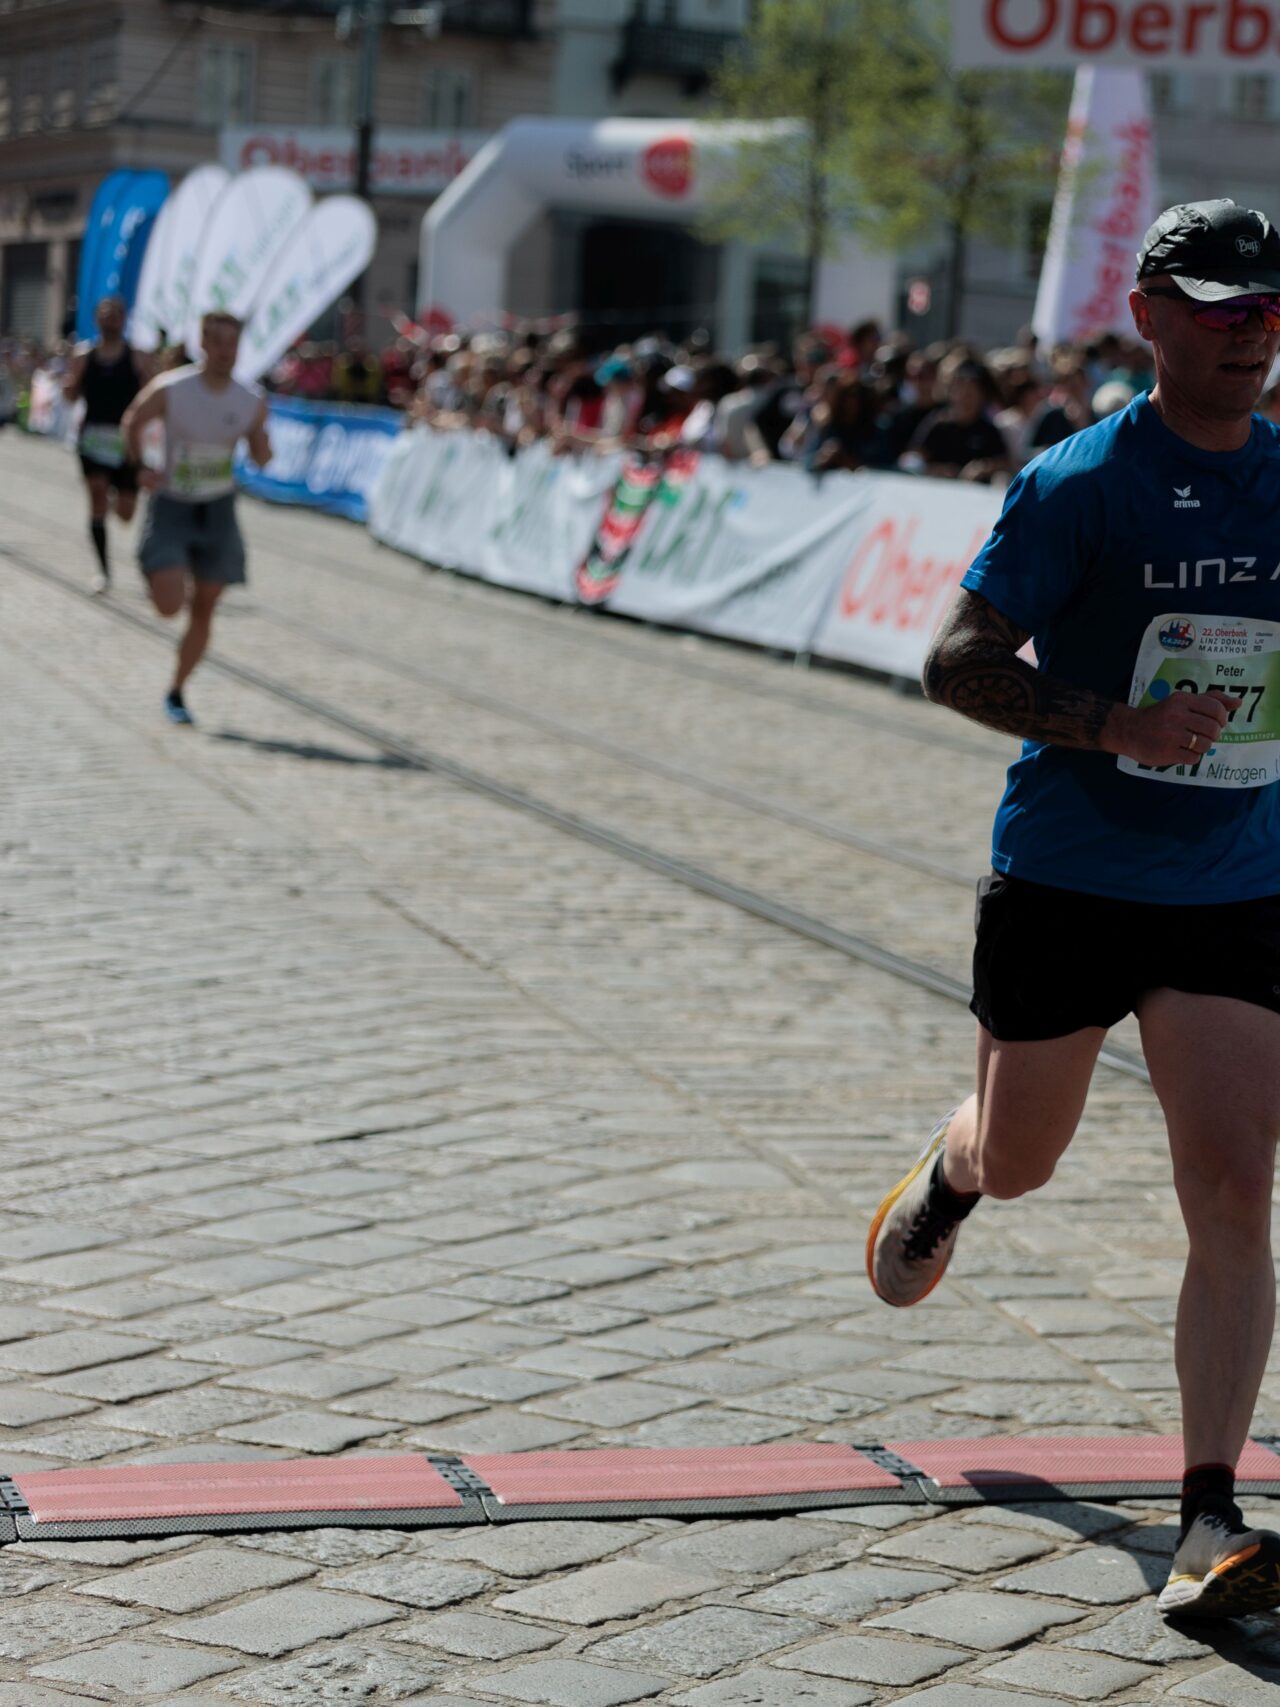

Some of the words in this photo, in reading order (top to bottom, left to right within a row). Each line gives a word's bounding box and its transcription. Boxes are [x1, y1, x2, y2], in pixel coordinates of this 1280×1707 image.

[1172, 497, 1201, 509] erima
[1143, 556, 1258, 590] LINZ
[1221, 638, 1248, 646] DONAU
[1198, 645, 1247, 654] MARATHON
[1215, 664, 1246, 677] Peter
[1206, 763, 1267, 785] Nitrogen
